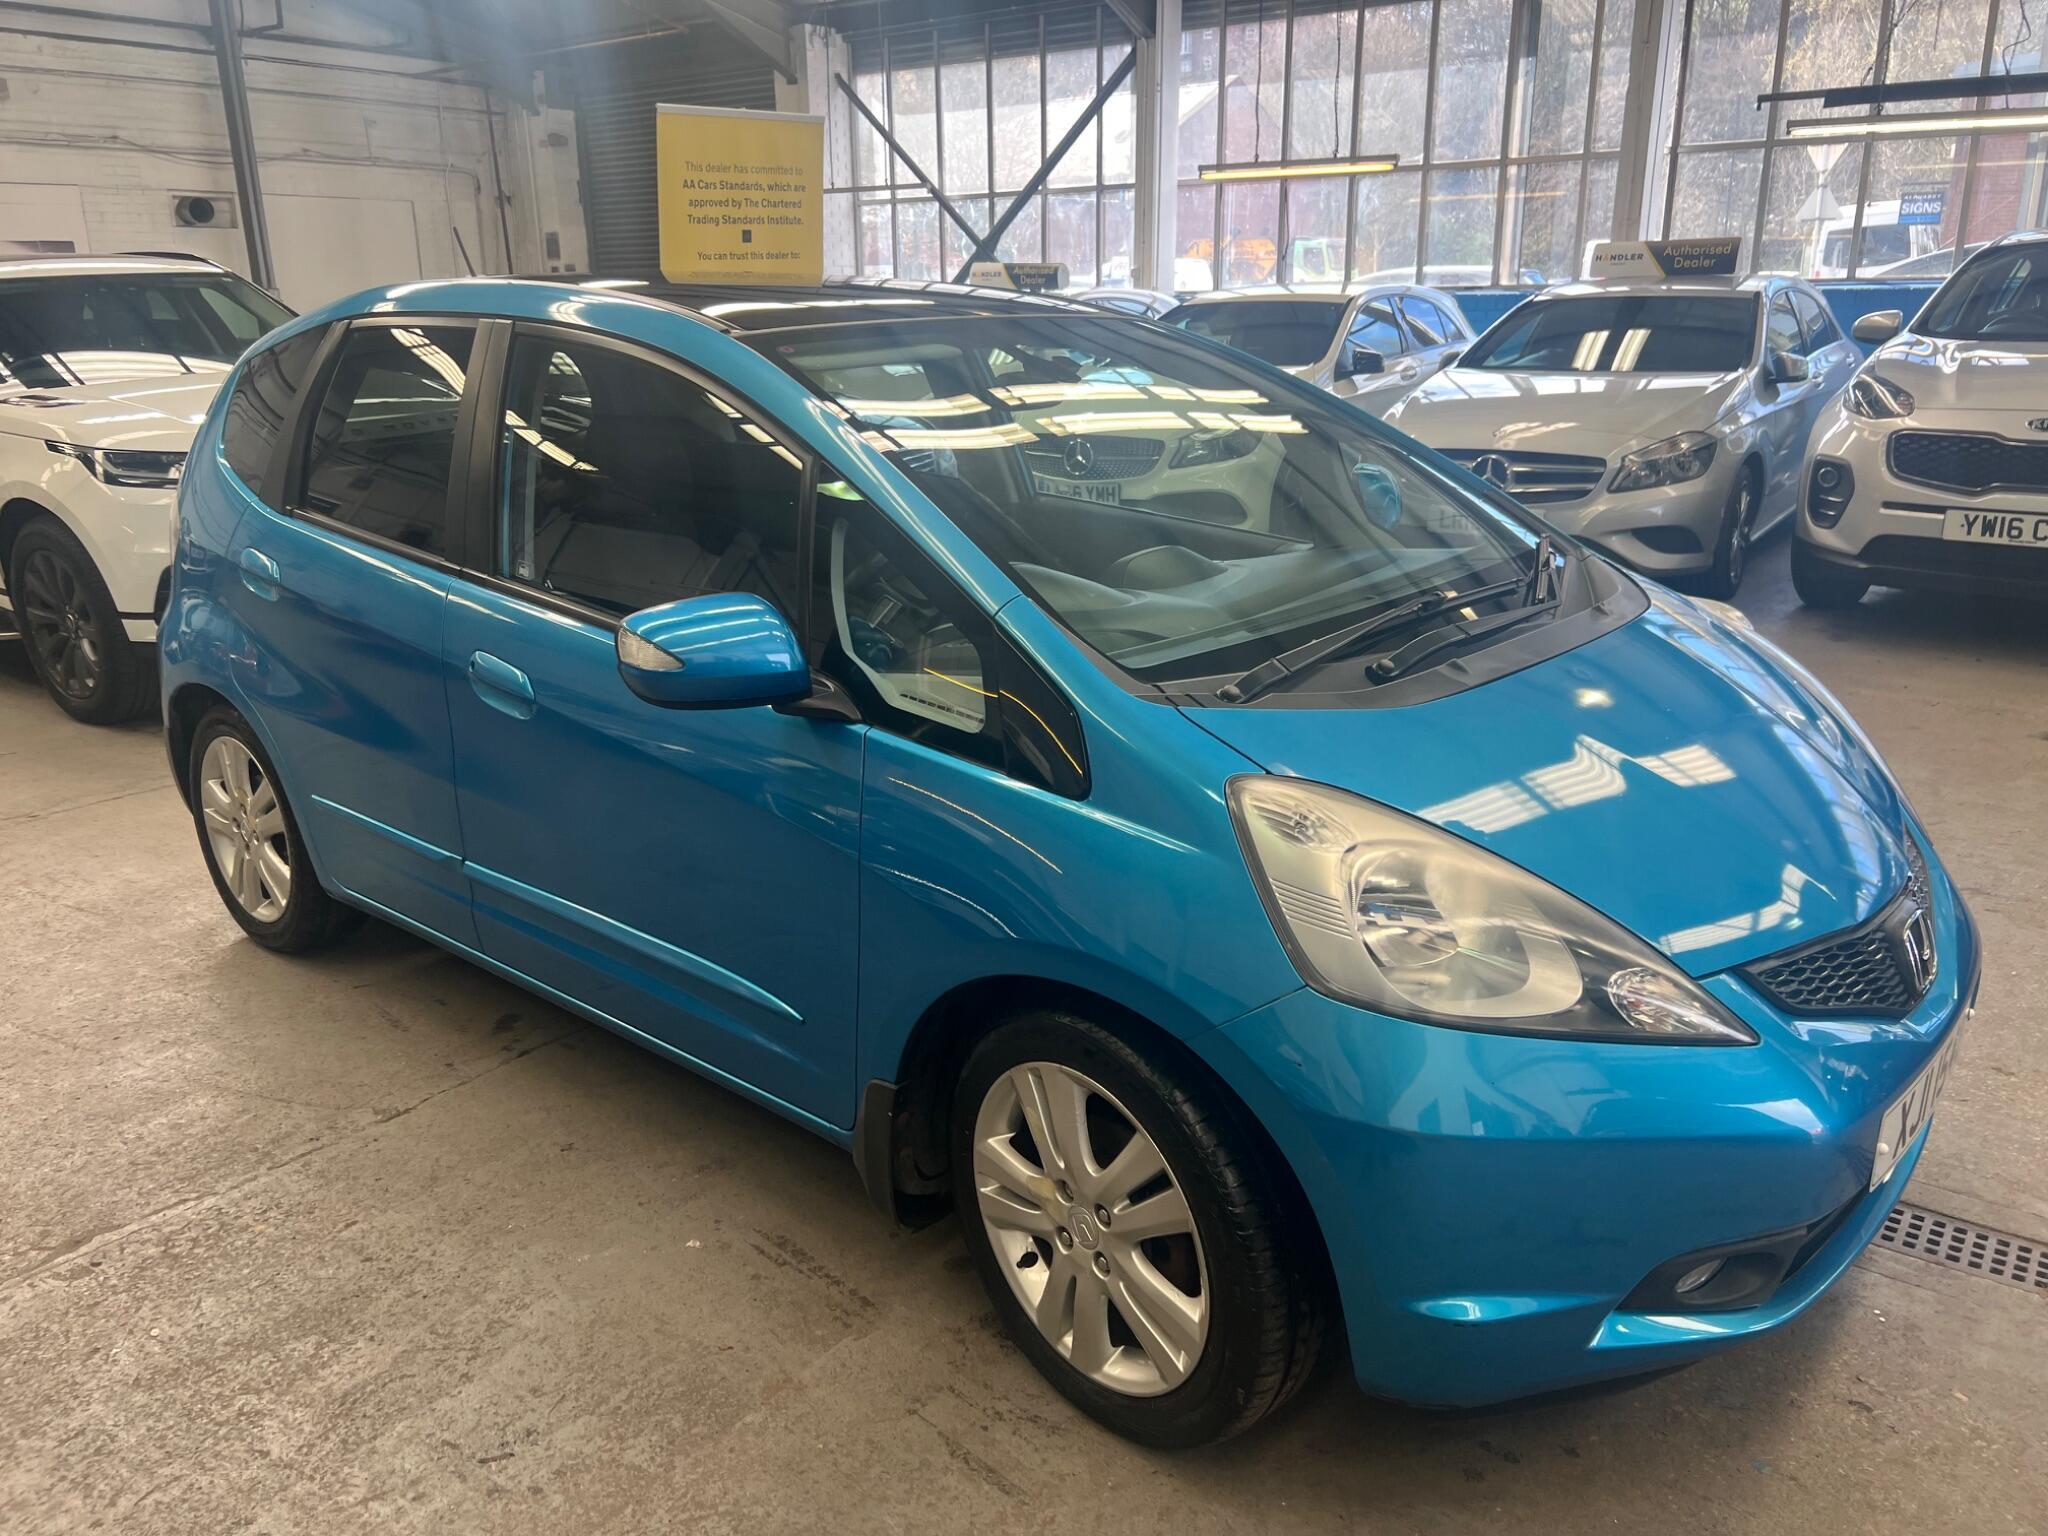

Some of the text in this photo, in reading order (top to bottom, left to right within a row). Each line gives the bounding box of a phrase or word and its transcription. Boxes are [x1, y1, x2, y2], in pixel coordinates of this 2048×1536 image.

[685, 161, 803, 176] This dealer has committed to
[682, 180, 806, 193] AA Cars Standards, which are
[688, 198, 802, 209] approved by The Chartered
[1901, 202, 1942, 214] SIGNS
[688, 214, 804, 227] Trading Standards Institute.
[697, 250, 801, 261] You can trust this dealer to:
[1664, 243, 1732, 257] Authorised
[1674, 257, 1716, 268] Dealer
[1020, 275, 1046, 284] Dealer
[1964, 514, 2024, 539] YW16
